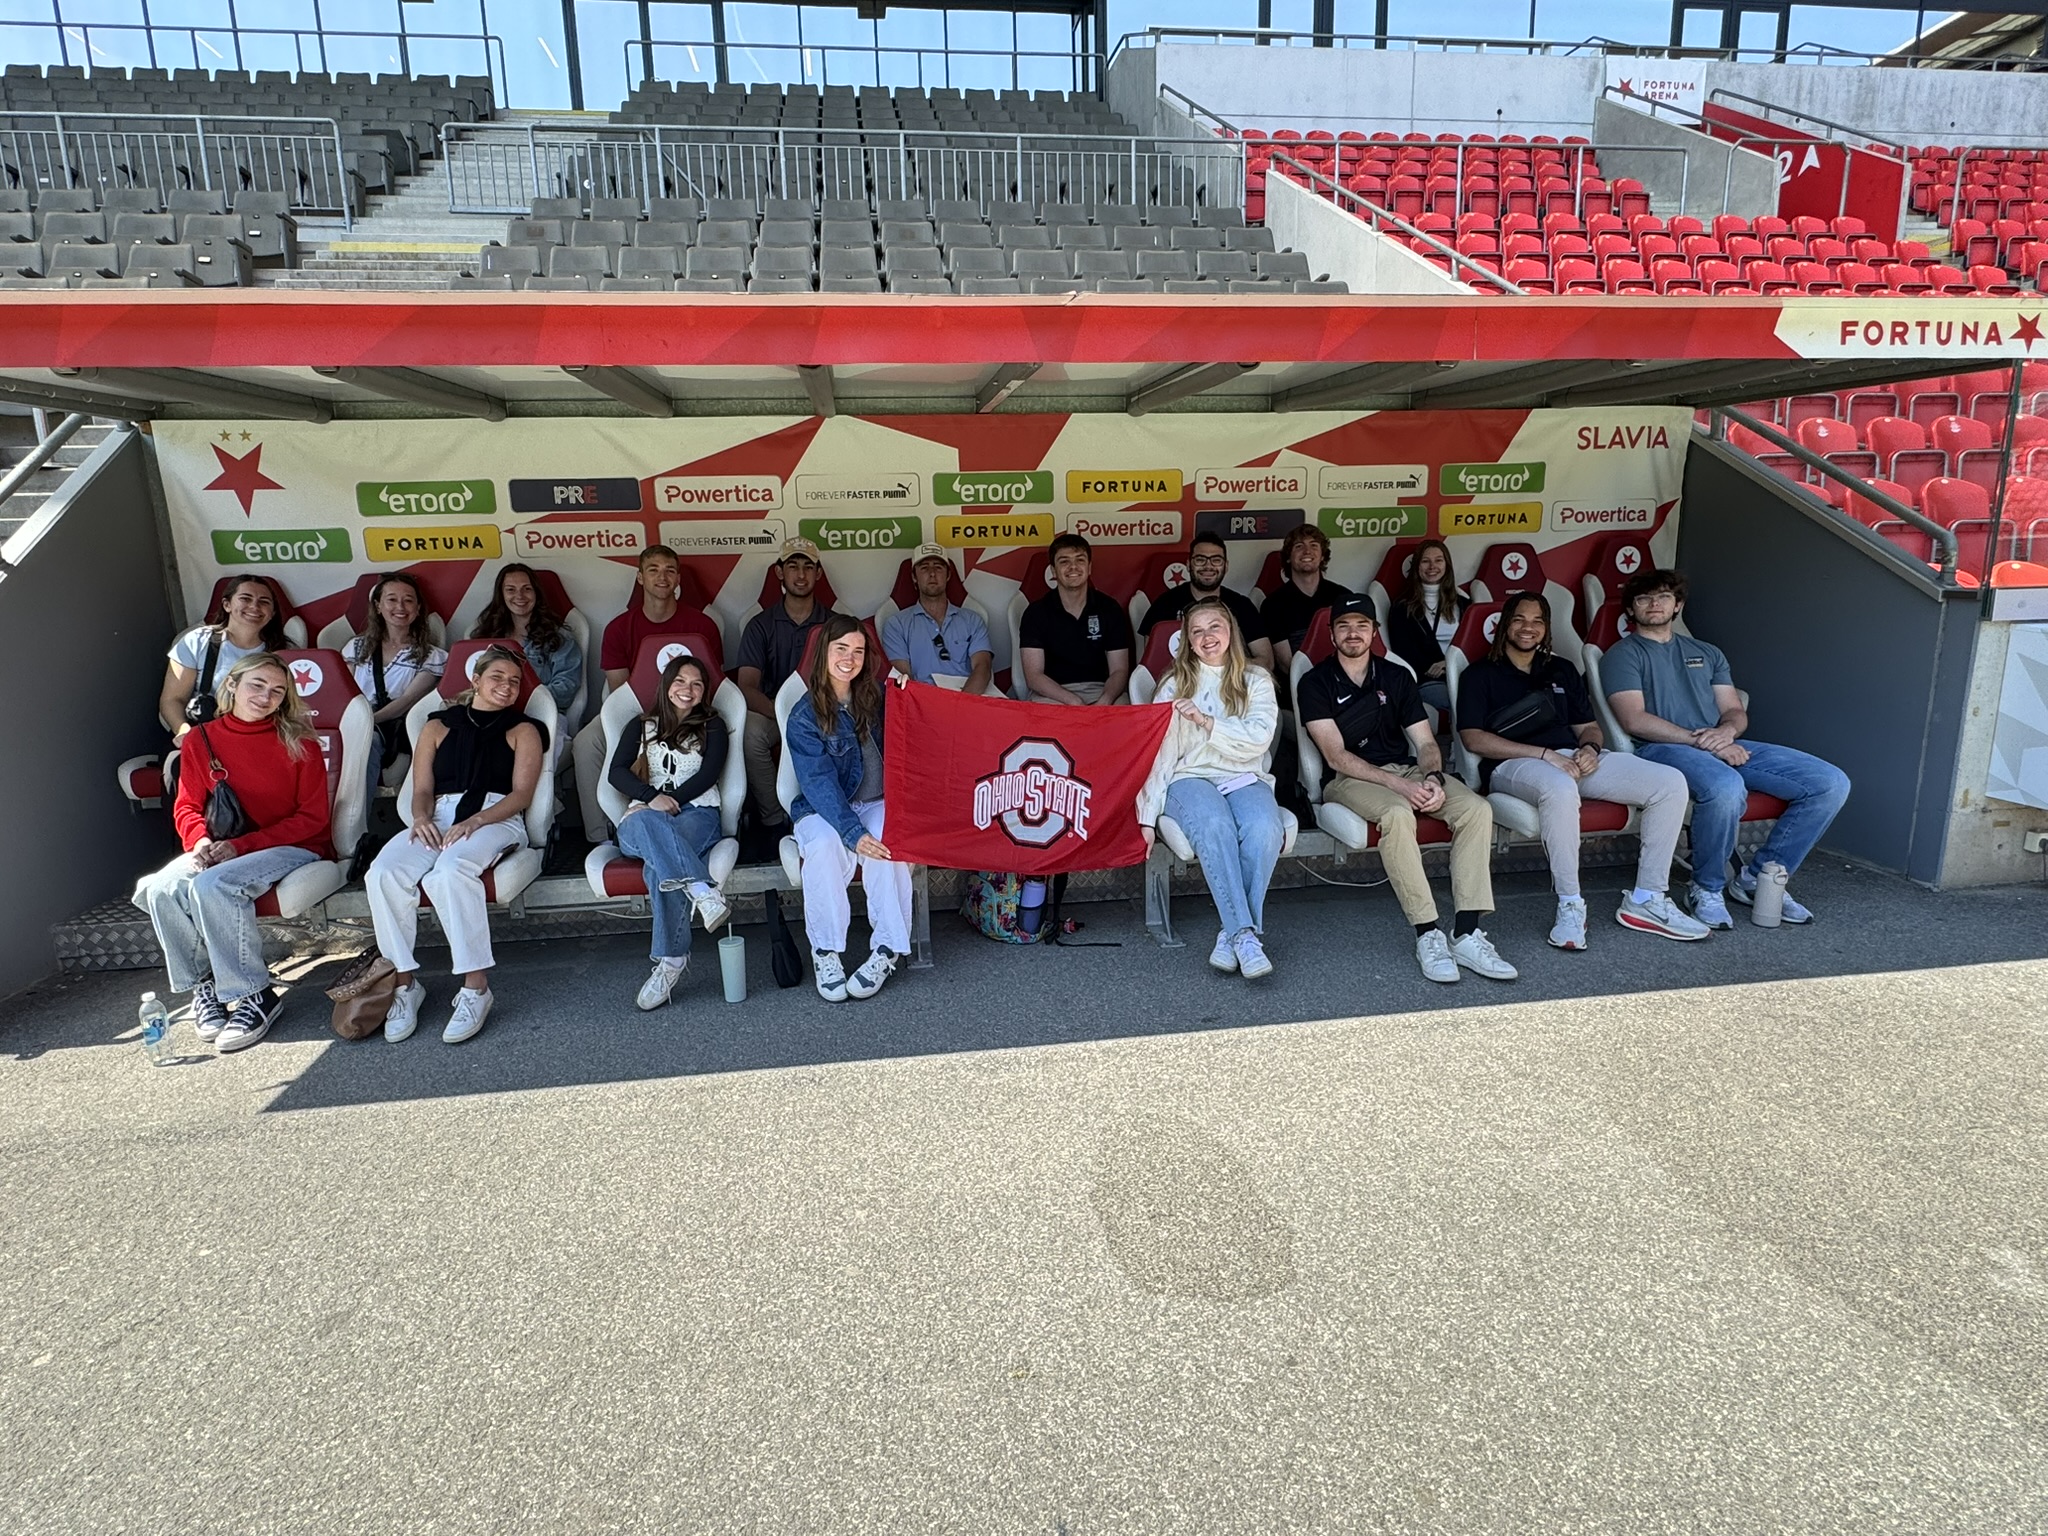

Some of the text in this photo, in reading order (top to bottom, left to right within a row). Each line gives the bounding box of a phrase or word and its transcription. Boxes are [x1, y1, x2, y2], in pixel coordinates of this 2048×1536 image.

[1643, 80, 1695, 91] FORTUNA
[1644, 91, 1679, 100] ARENA
[1840, 320, 2003, 346] FORTUNA
[1577, 426, 1669, 450] SLAVIA
[1081, 479, 1168, 494] FORTUNA
[1203, 475, 1299, 494] Powertica
[1327, 482, 1362, 490] FOREVER
[553, 485, 598, 505] PRE
[664, 484, 774, 504] Powertica
[805, 490, 846, 501] FOREVER
[883, 489, 906, 499] PUMA
[1454, 512, 1528, 526] FORTUNA
[1560, 506, 1647, 524] Powertica
[951, 525, 1040, 539] FORTUNA
[1074, 519, 1174, 537] Powertica
[1230, 516, 1268, 534] PRE
[384, 536, 483, 552] FORTUNA
[525, 528, 638, 550] Powertica
[669, 537, 711, 547] FOREVER
